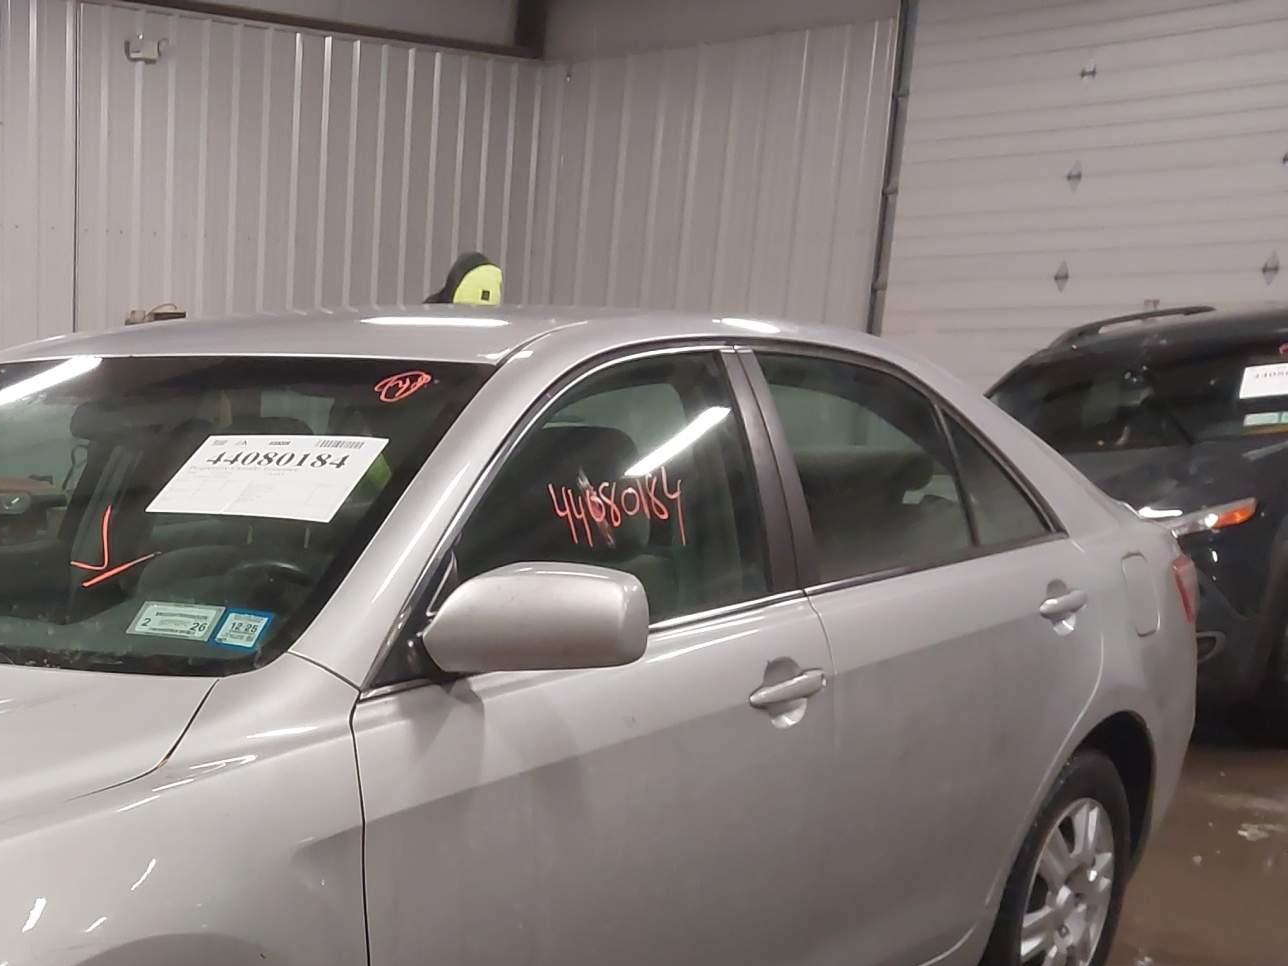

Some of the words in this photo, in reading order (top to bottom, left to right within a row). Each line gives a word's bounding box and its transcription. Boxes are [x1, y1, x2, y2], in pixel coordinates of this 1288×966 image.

[206, 450, 351, 470] 44080184
[548, 466, 686, 547] 44080184
[189, 622, 207, 633] 26
